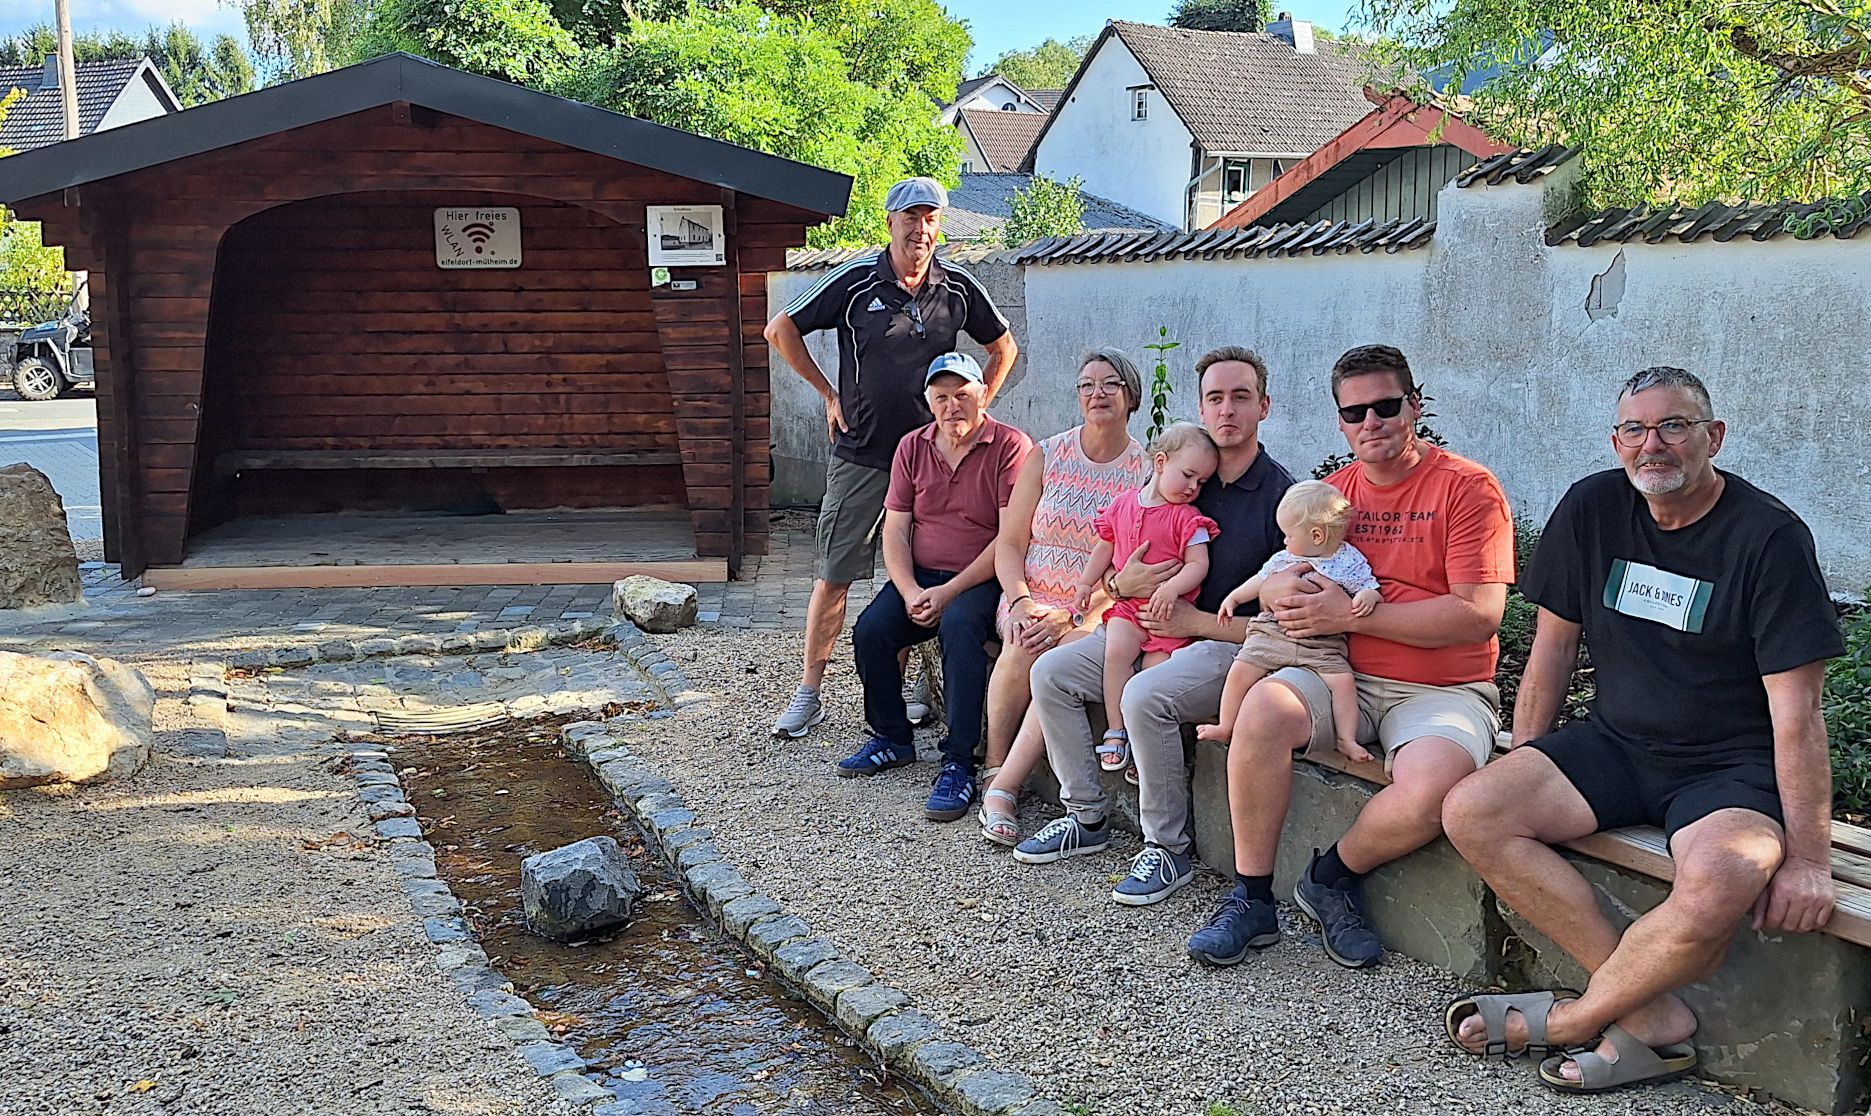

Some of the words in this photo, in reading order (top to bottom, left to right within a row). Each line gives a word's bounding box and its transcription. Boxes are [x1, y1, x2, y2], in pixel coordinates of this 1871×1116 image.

[446, 210, 469, 221] Hier
[475, 210, 507, 221] freies
[441, 224, 465, 257] WLAN
[441, 258, 518, 266] eifeldorf-mülheim.de
[1357, 511, 1401, 522] TAILOR
[1354, 524, 1376, 534] EST
[1628, 581, 1653, 598] JACK
[1655, 587, 1661, 600] &
[1661, 590, 1684, 607] NES
